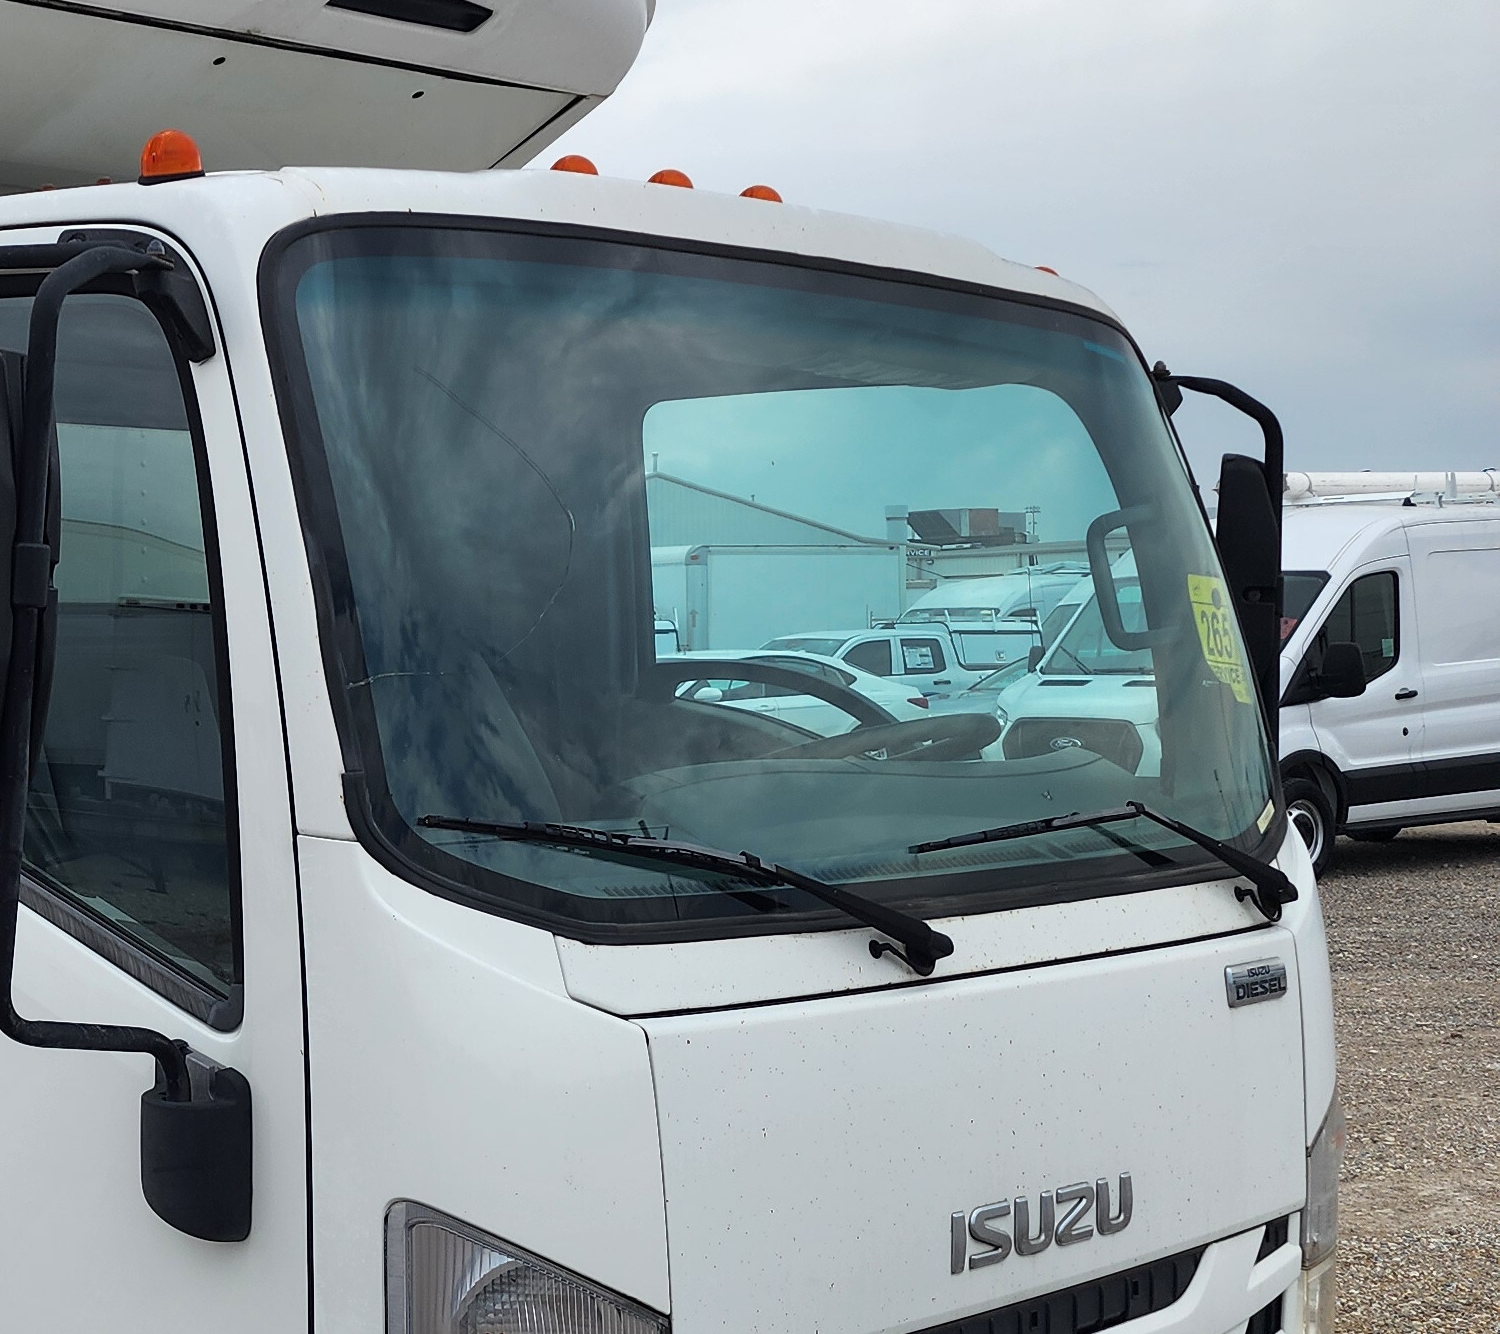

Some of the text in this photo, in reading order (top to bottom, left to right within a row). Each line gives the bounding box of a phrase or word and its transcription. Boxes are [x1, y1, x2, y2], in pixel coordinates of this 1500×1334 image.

[1200, 609, 1233, 659] 265
[1236, 977, 1286, 1001] DIESEL
[1247, 965, 1270, 977] ISUZU
[950, 1171, 1134, 1275] ISUZU
